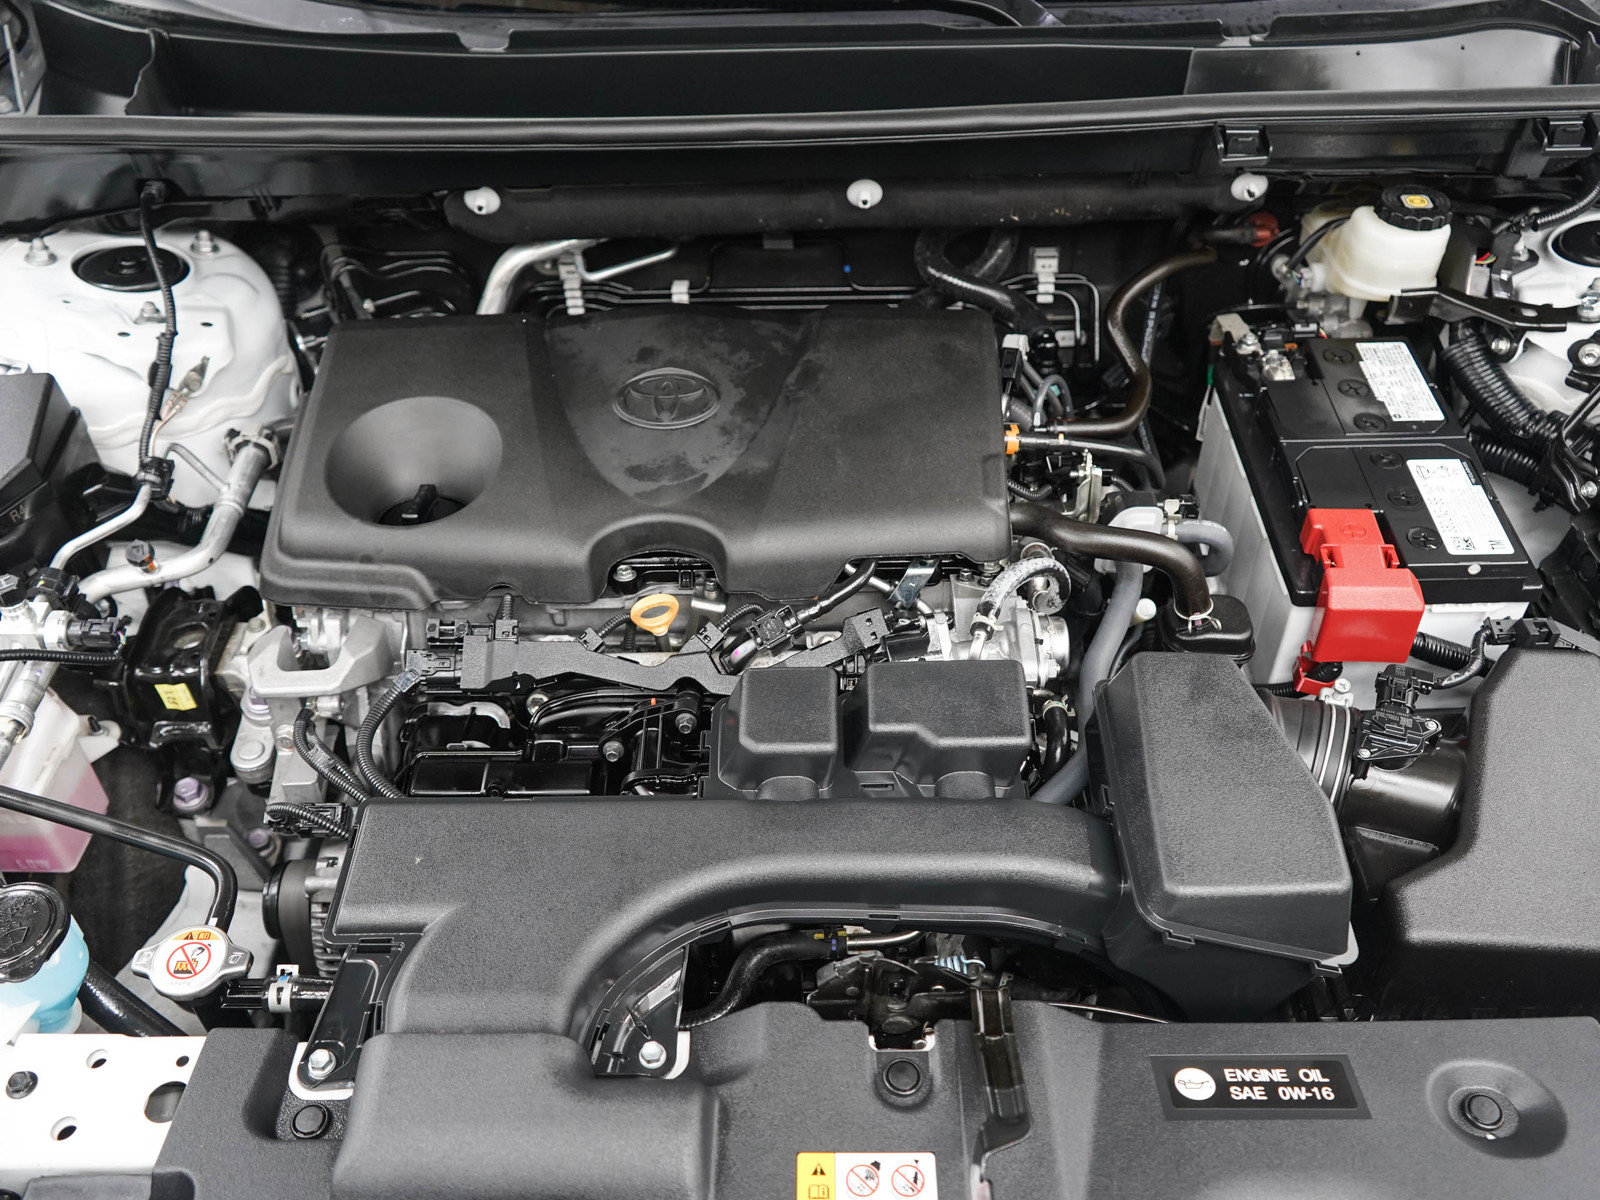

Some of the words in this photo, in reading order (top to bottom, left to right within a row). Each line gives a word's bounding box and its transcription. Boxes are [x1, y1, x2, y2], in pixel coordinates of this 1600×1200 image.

[1223, 1068, 1290, 1082] ENGINE
[1298, 1068, 1330, 1082] OIL
[1229, 1086, 1268, 1100] SAE
[1277, 1086, 1335, 1100] 0W-16
